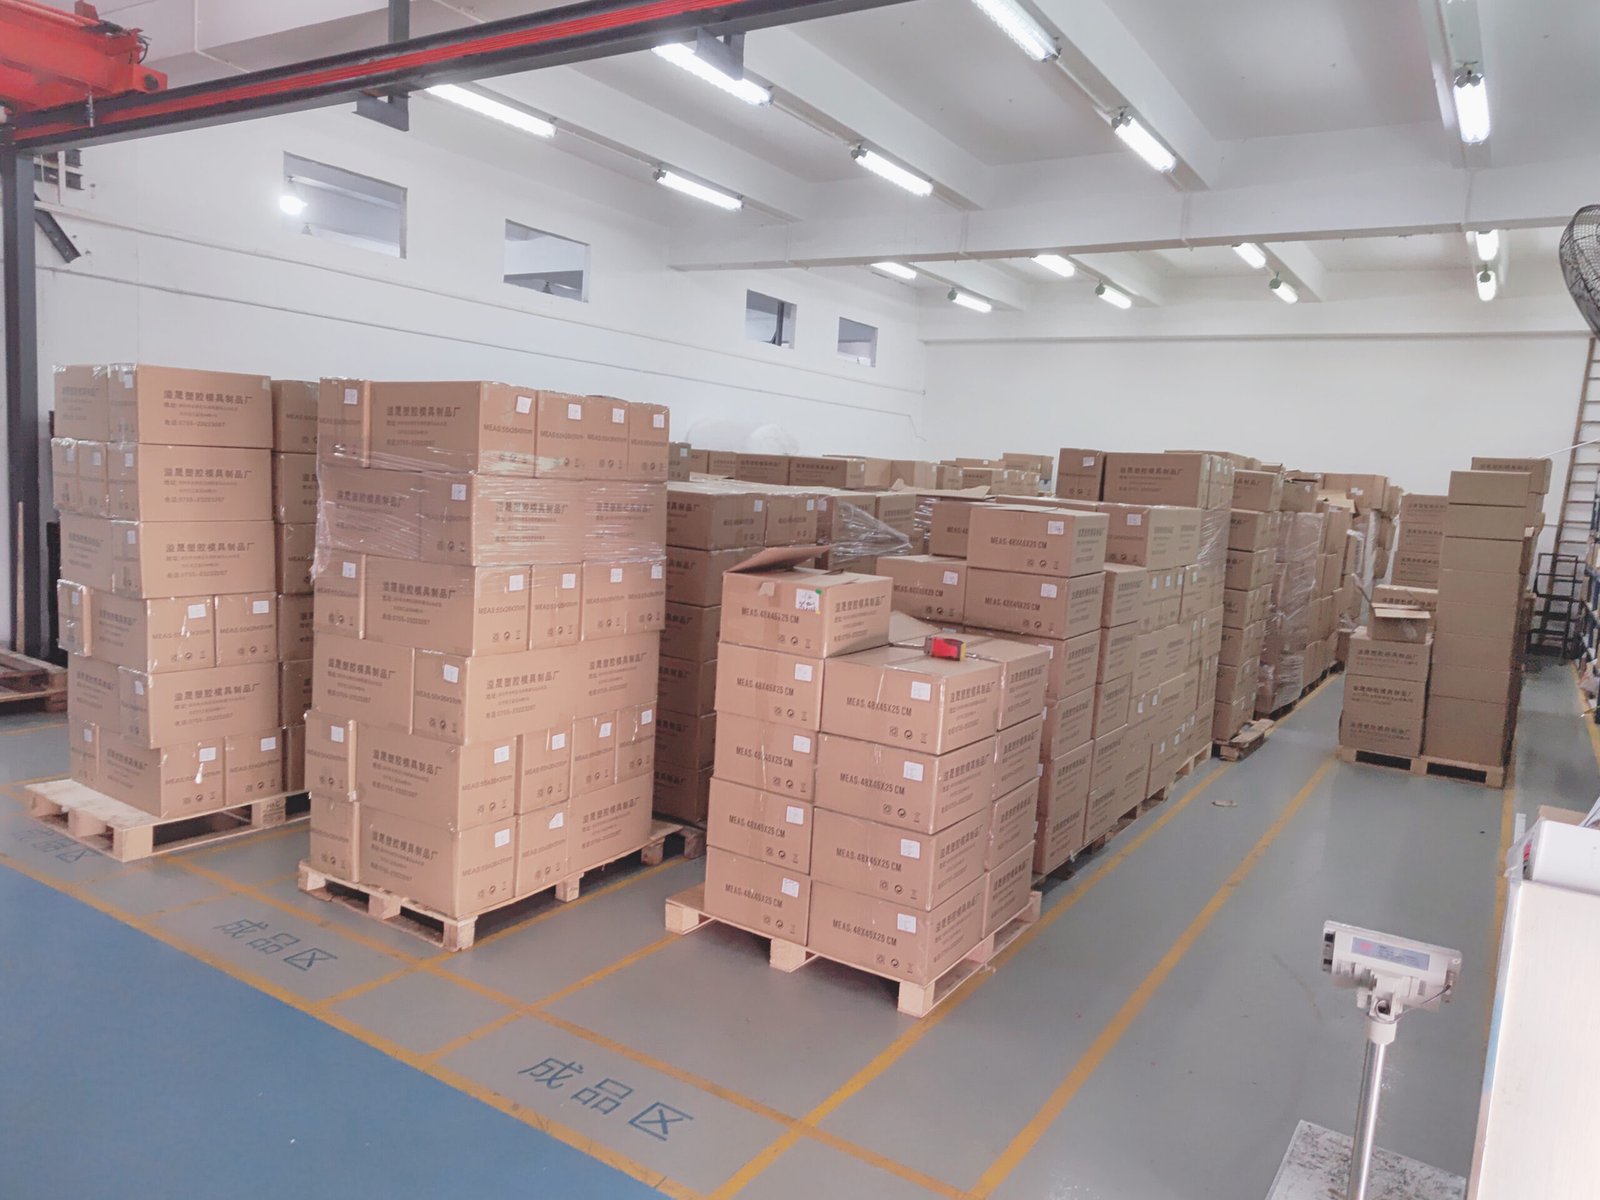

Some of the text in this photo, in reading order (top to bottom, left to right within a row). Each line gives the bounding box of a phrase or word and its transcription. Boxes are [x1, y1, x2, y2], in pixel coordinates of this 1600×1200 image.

[1038, 541, 1047, 549] CM
[1031, 603, 1040, 611] CM
[790, 615, 800, 624] CM
[785, 687, 794, 696] CM
[901, 706, 912, 717] CM
[784, 757, 793, 767] CM
[894, 785, 905, 796] CM
[776, 828, 786, 838] CM
[891, 862, 902, 872] CM
[773, 898, 783, 908] CM
[212, 919, 338, 972] 成品区
[886, 936, 897, 946] CM
[517, 1057, 694, 1141] 成品区
